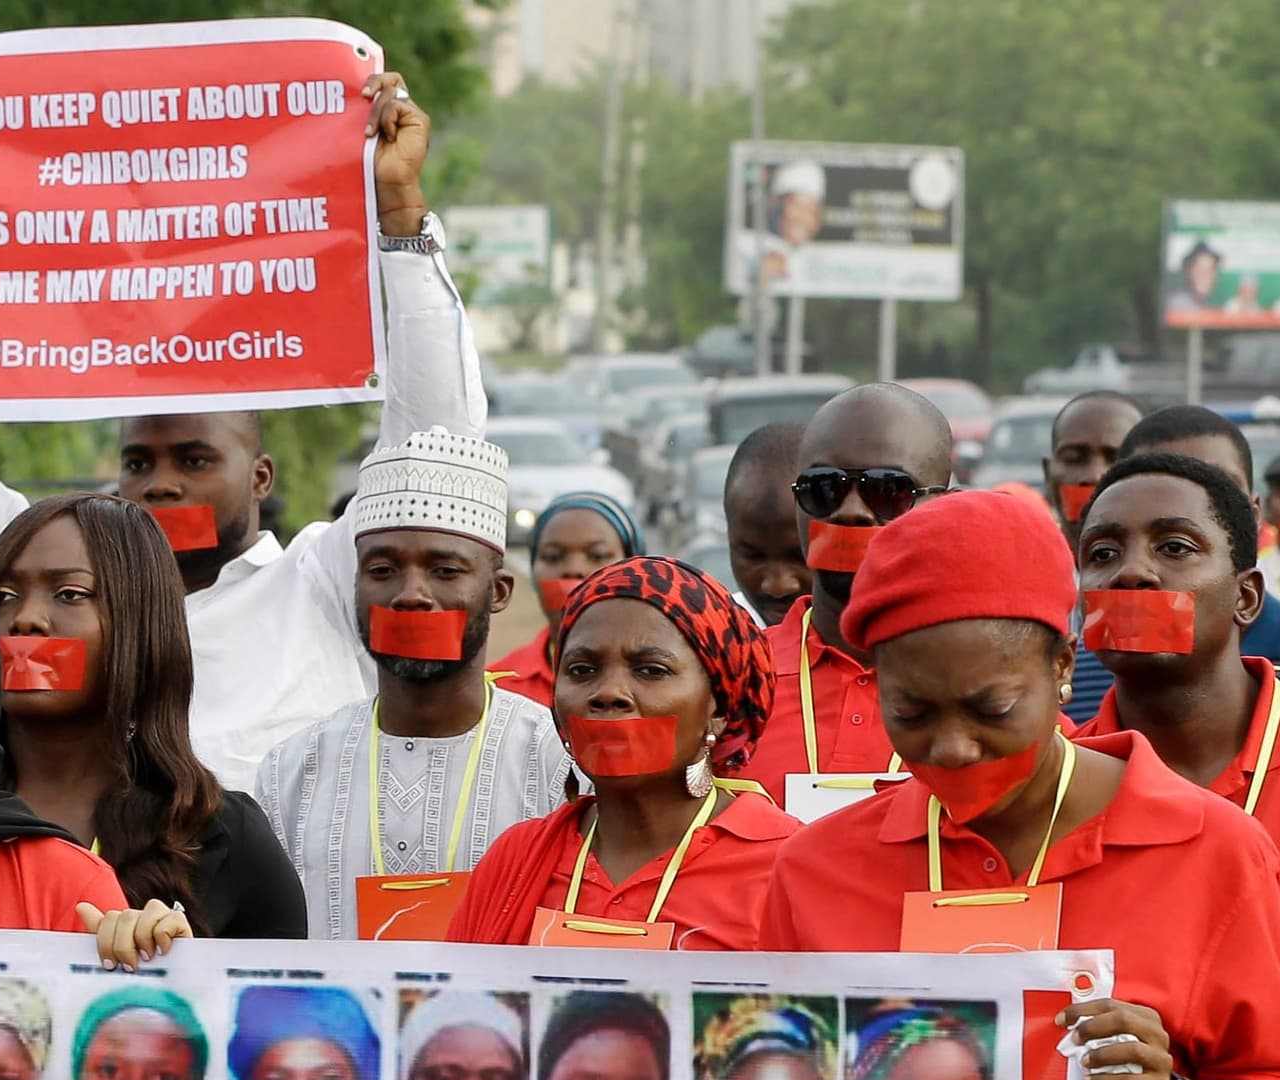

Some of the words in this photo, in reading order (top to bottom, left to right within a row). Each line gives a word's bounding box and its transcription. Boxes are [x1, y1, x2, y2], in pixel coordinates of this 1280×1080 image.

[31, 93, 95, 127] KEEP
[102, 88, 180, 127] QUIET
[188, 84, 280, 120] ABOUT
[287, 81, 344, 115] OUR
[39, 145, 247, 185] #CHIBOKGIRLS
[16, 210, 85, 244] ONLY
[90, 210, 110, 242] A
[117, 205, 218, 242] MATTER
[225, 202, 256, 236] OF
[261, 198, 328, 233] TIME
[46, 269, 106, 303] MAY
[110, 264, 214, 300] HAPPEN
[220, 261, 253, 295] TO
[260, 258, 315, 292] YOU
